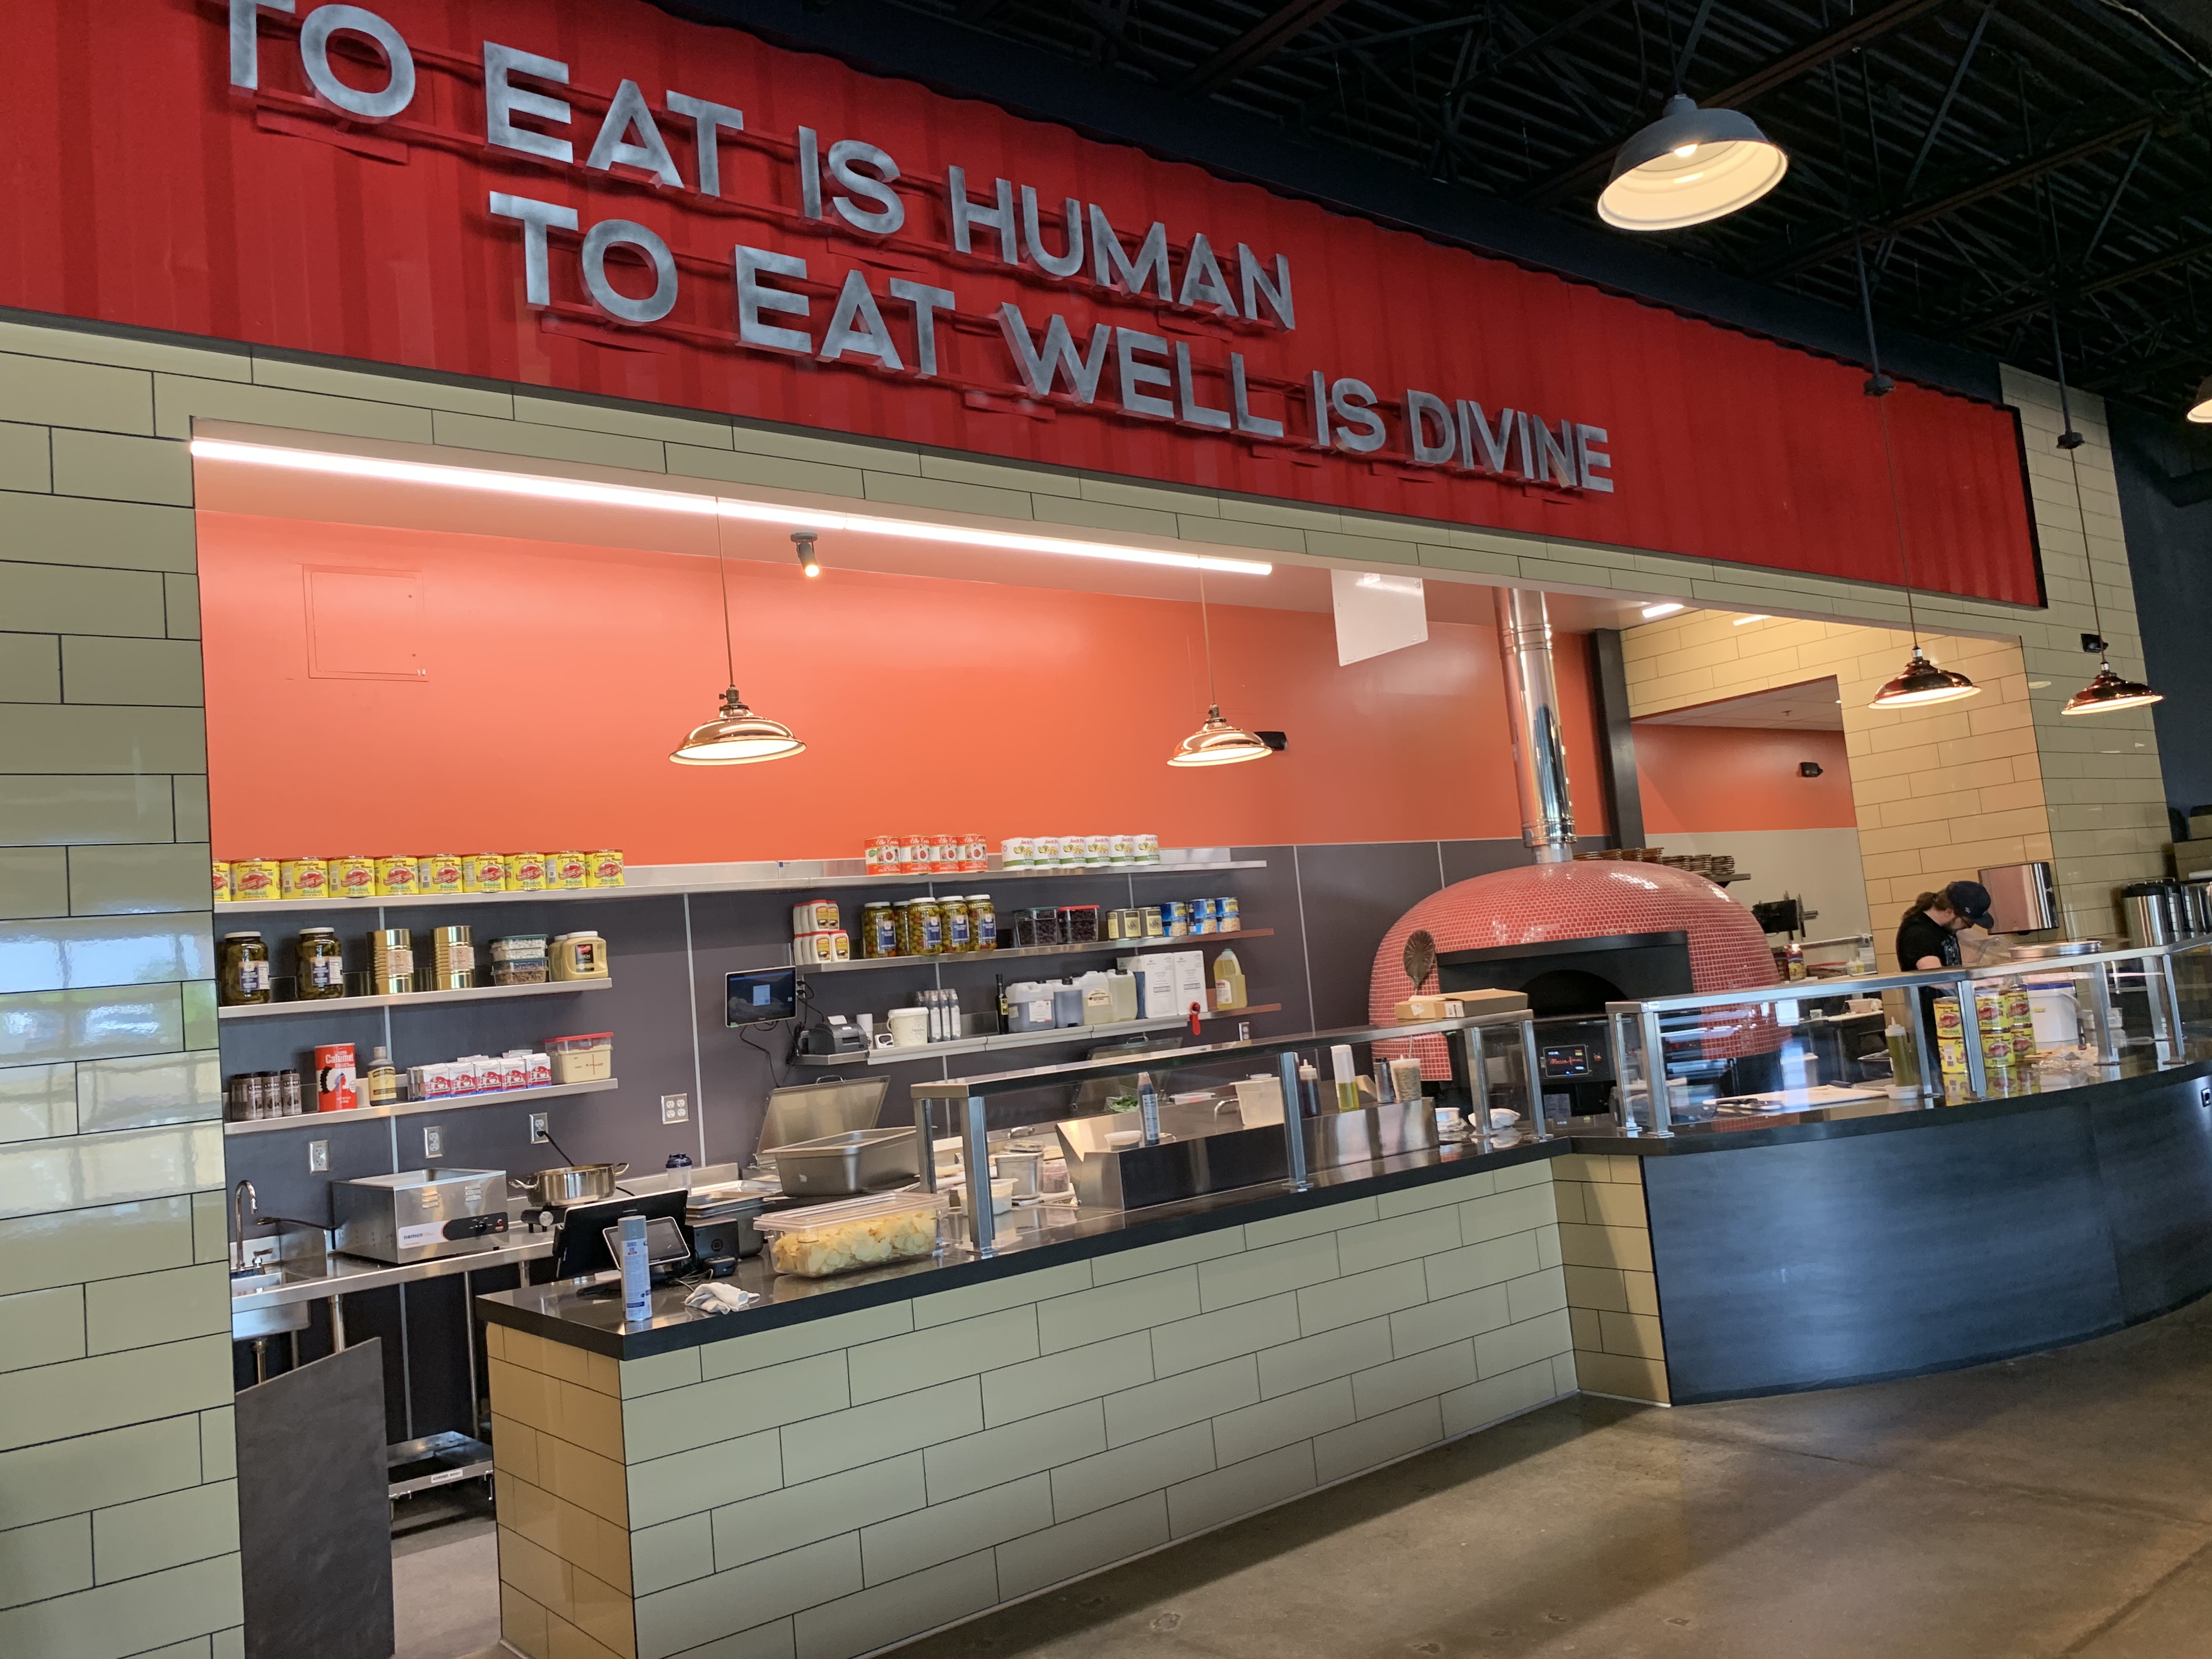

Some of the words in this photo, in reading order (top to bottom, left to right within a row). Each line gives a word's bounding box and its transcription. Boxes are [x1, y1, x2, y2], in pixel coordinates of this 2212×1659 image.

[227, 0, 416, 118] TO
[483, 40, 744, 198] EAT
[797, 125, 905, 235] IS
[947, 165, 1296, 331] HUMAN
[489, 190, 679, 323] TO
[734, 244, 956, 377] EAT
[996, 302, 1284, 438] WELL
[1311, 370, 1386, 453] IS
[1403, 388, 1614, 493] DIVINE
[325, 1052, 354, 1064] Calumet
